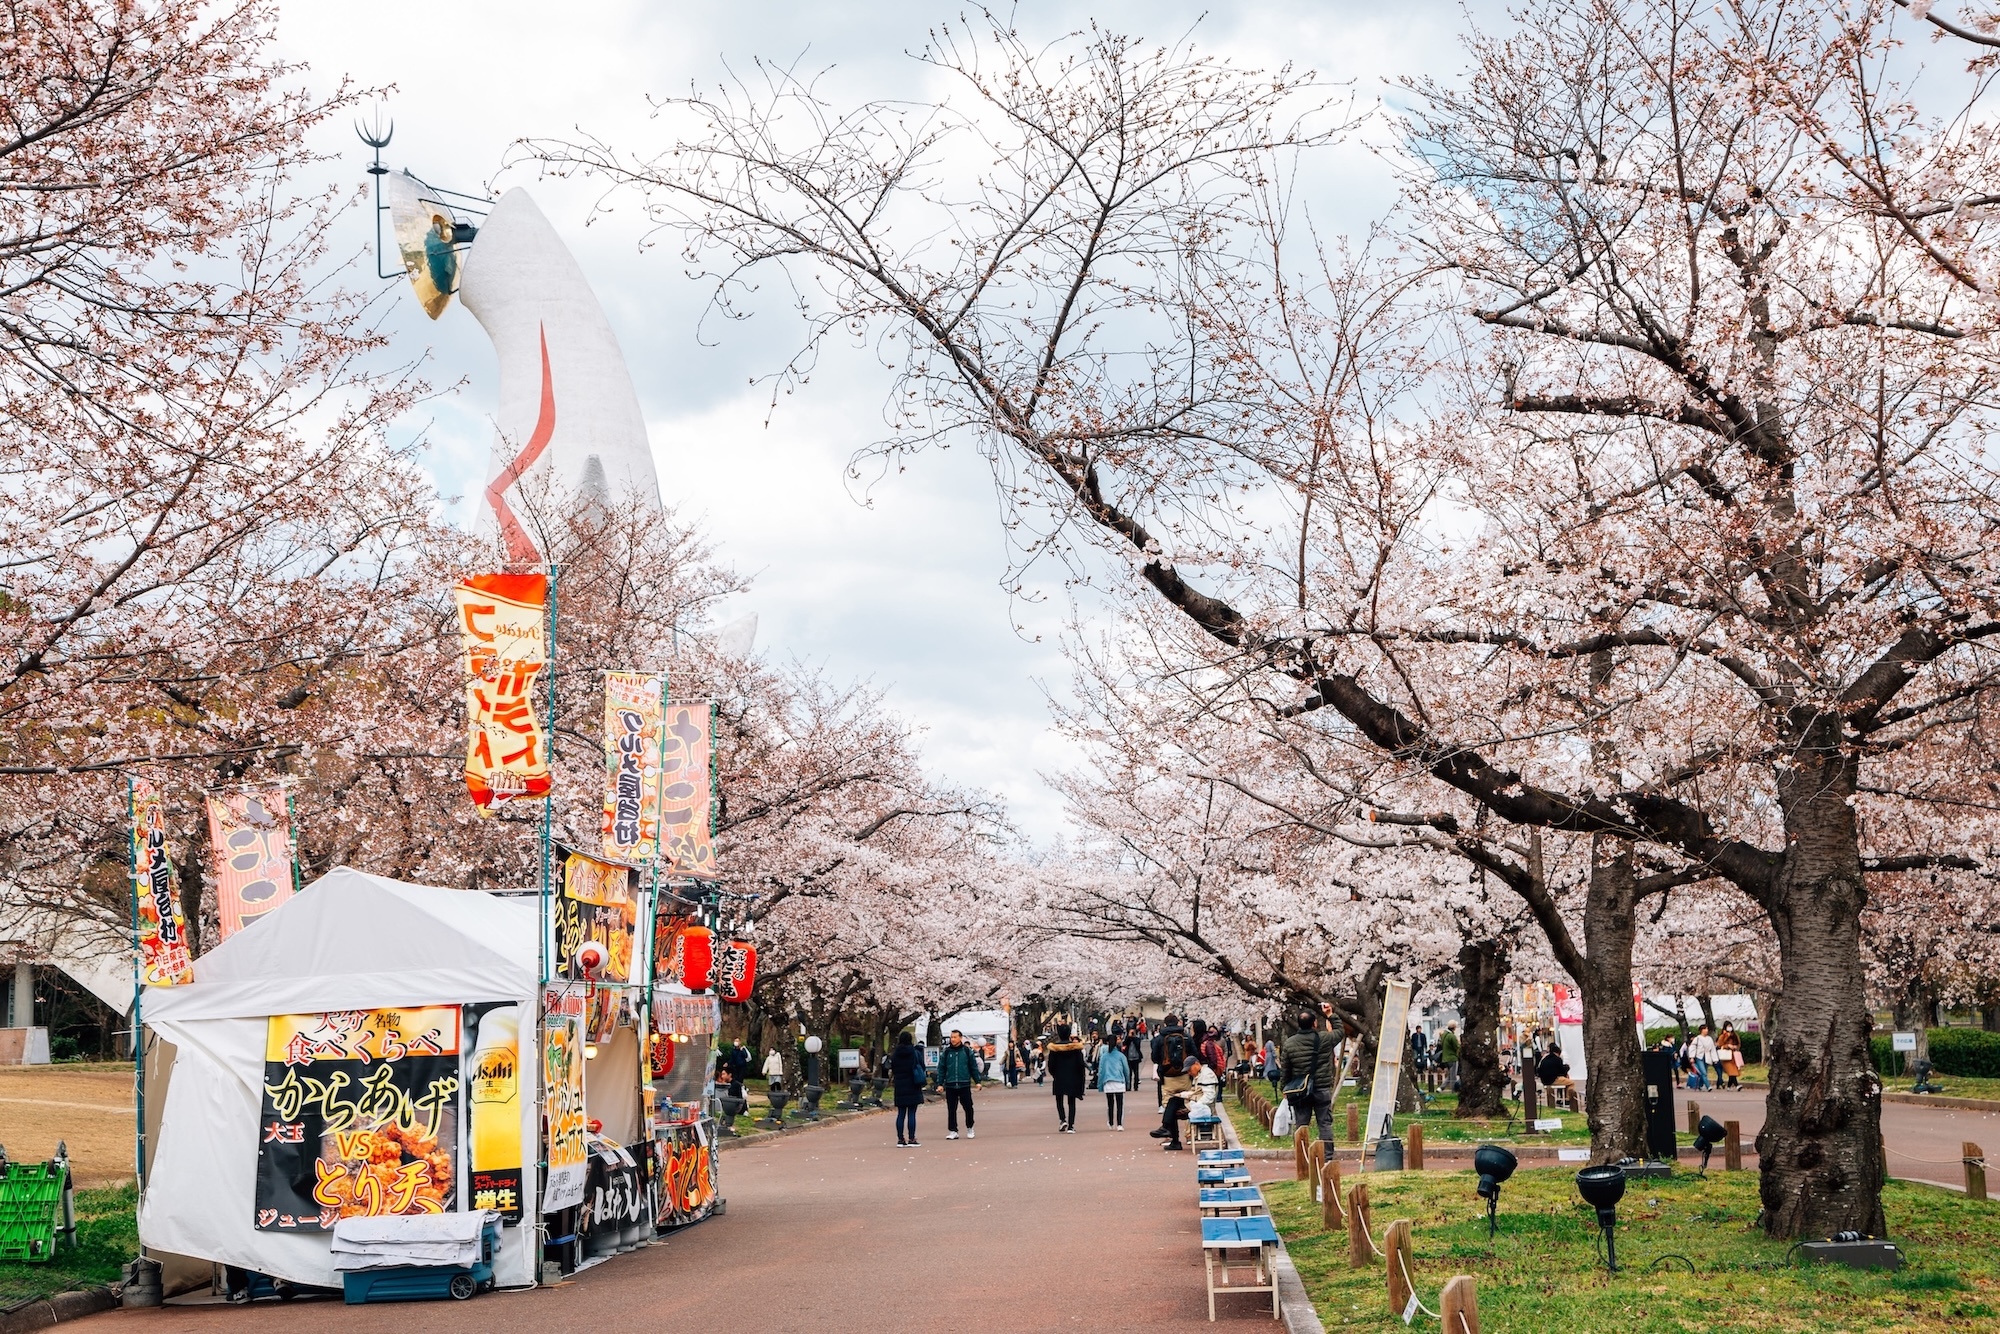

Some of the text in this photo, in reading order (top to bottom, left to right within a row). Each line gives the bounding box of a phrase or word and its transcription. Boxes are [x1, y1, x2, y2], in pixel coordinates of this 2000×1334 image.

[721, 946, 737, 997] 大たこ焼
[313, 1009, 370, 1033] 大分
[374, 1012, 401, 1028] 名物
[285, 1028, 443, 1067] 食べくらべ
[472, 1062, 512, 1081] Asahi
[265, 1064, 459, 1142] からあげ
[335, 1131, 374, 1160] VS
[555, 1122, 587, 1158] チップス
[313, 1157, 446, 1217] とり天
[474, 1179, 517, 1190] スーパードライ
[475, 1189, 518, 1211] 樽生
